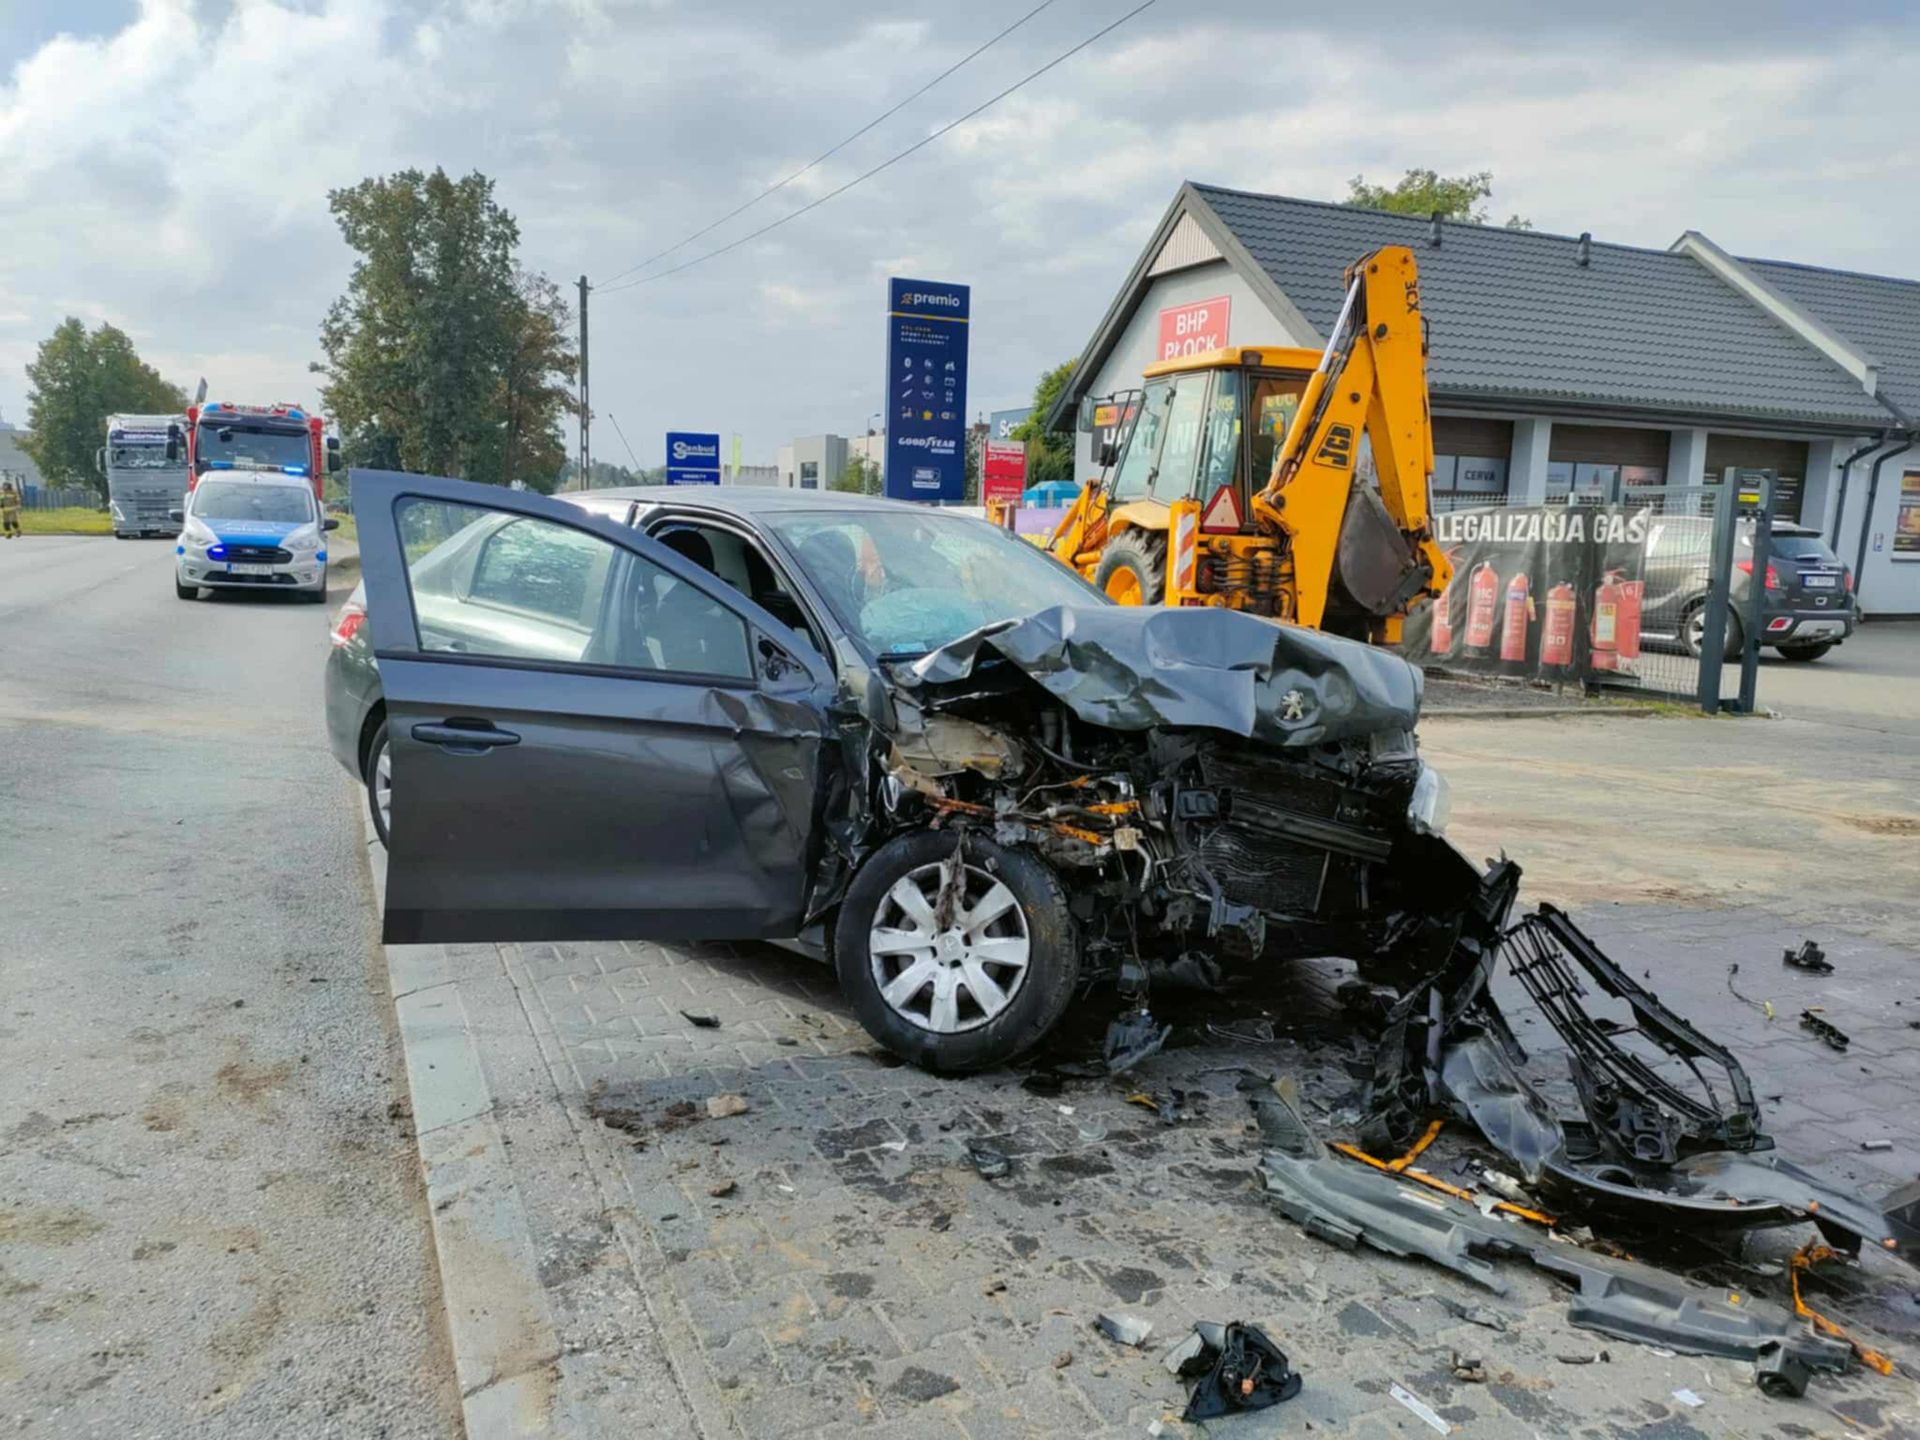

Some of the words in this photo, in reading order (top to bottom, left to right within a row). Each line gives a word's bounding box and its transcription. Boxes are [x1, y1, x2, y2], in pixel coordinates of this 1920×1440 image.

[913, 293, 960, 307] premio
[1404, 279, 1419, 314] 3CX
[1176, 309, 1208, 335] BHP
[898, 436, 956, 449] GOODYEAR
[1318, 426, 1351, 466] JCB
[1464, 469, 1496, 481] CERVA
[1438, 514, 1585, 543] LEGALIZACJA
